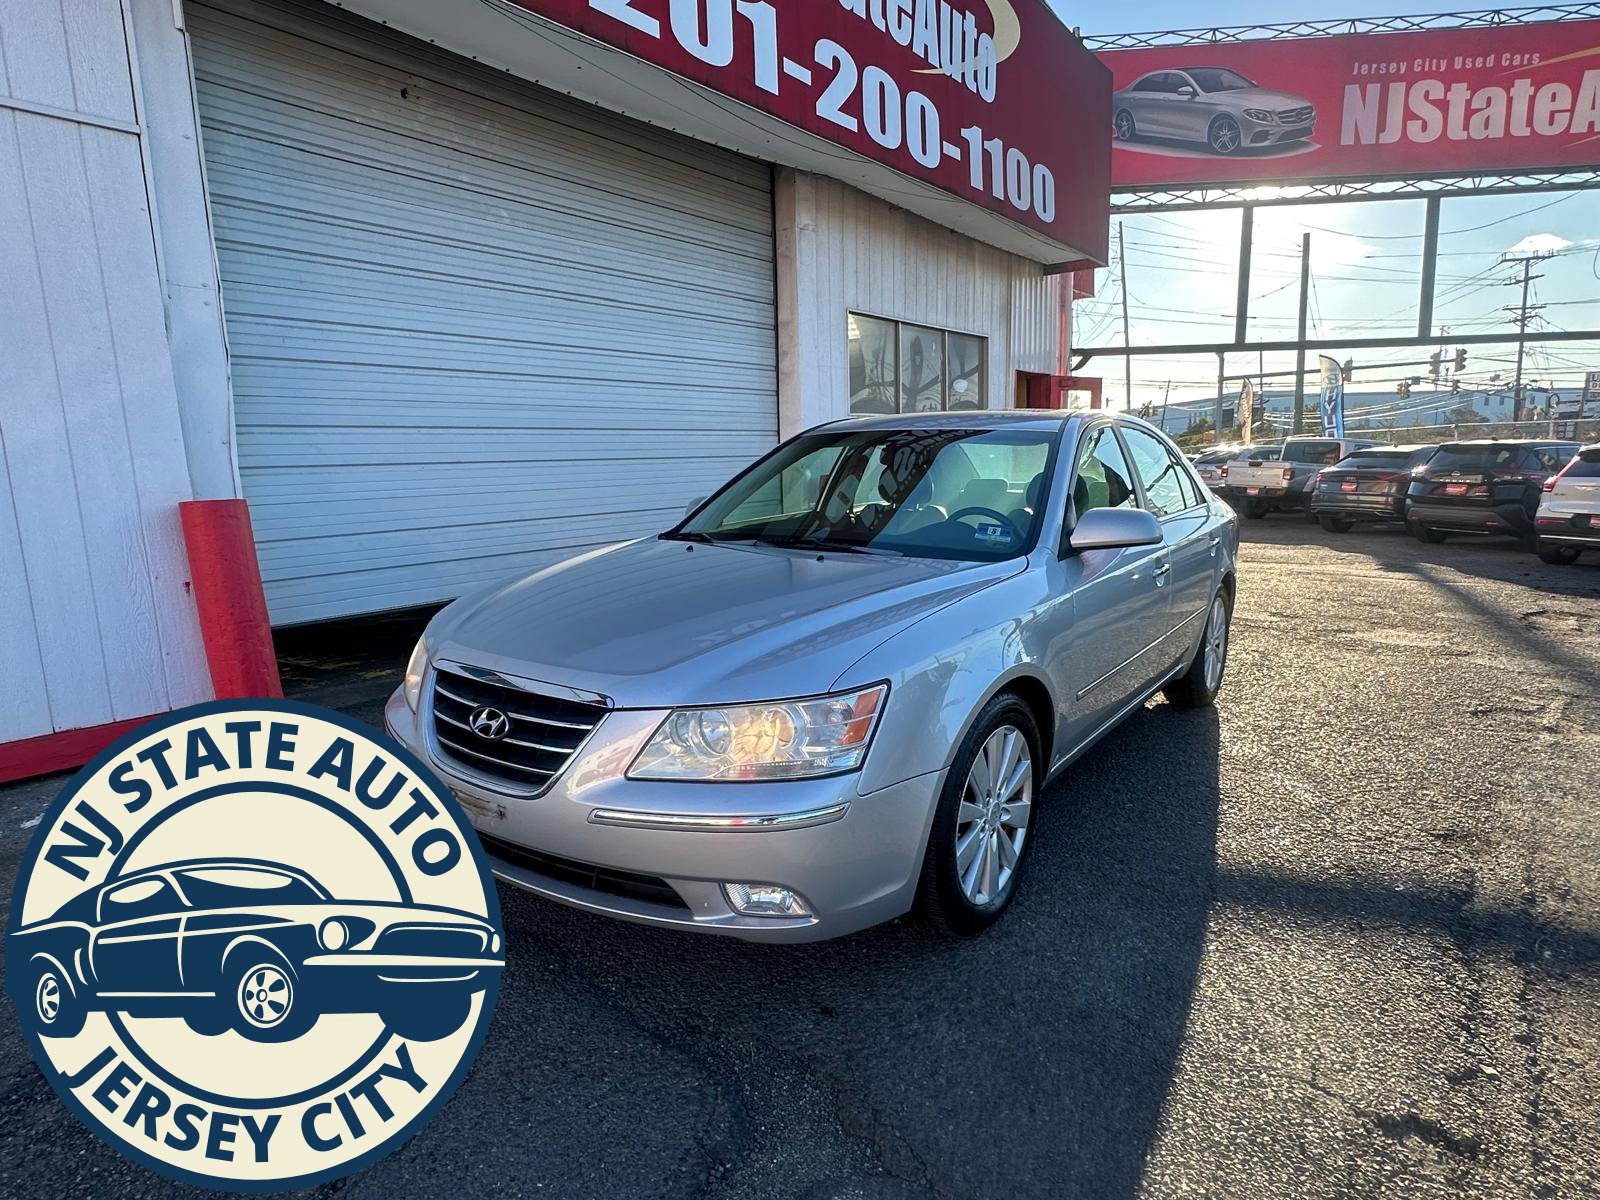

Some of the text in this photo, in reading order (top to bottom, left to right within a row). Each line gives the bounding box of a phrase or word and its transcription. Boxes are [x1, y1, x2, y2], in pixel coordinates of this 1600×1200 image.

[838, 0, 997, 103] eAuto
[1352, 52, 1541, 75] Jersey City Used Cars
[588, 0, 1055, 223] 01-200-1100
